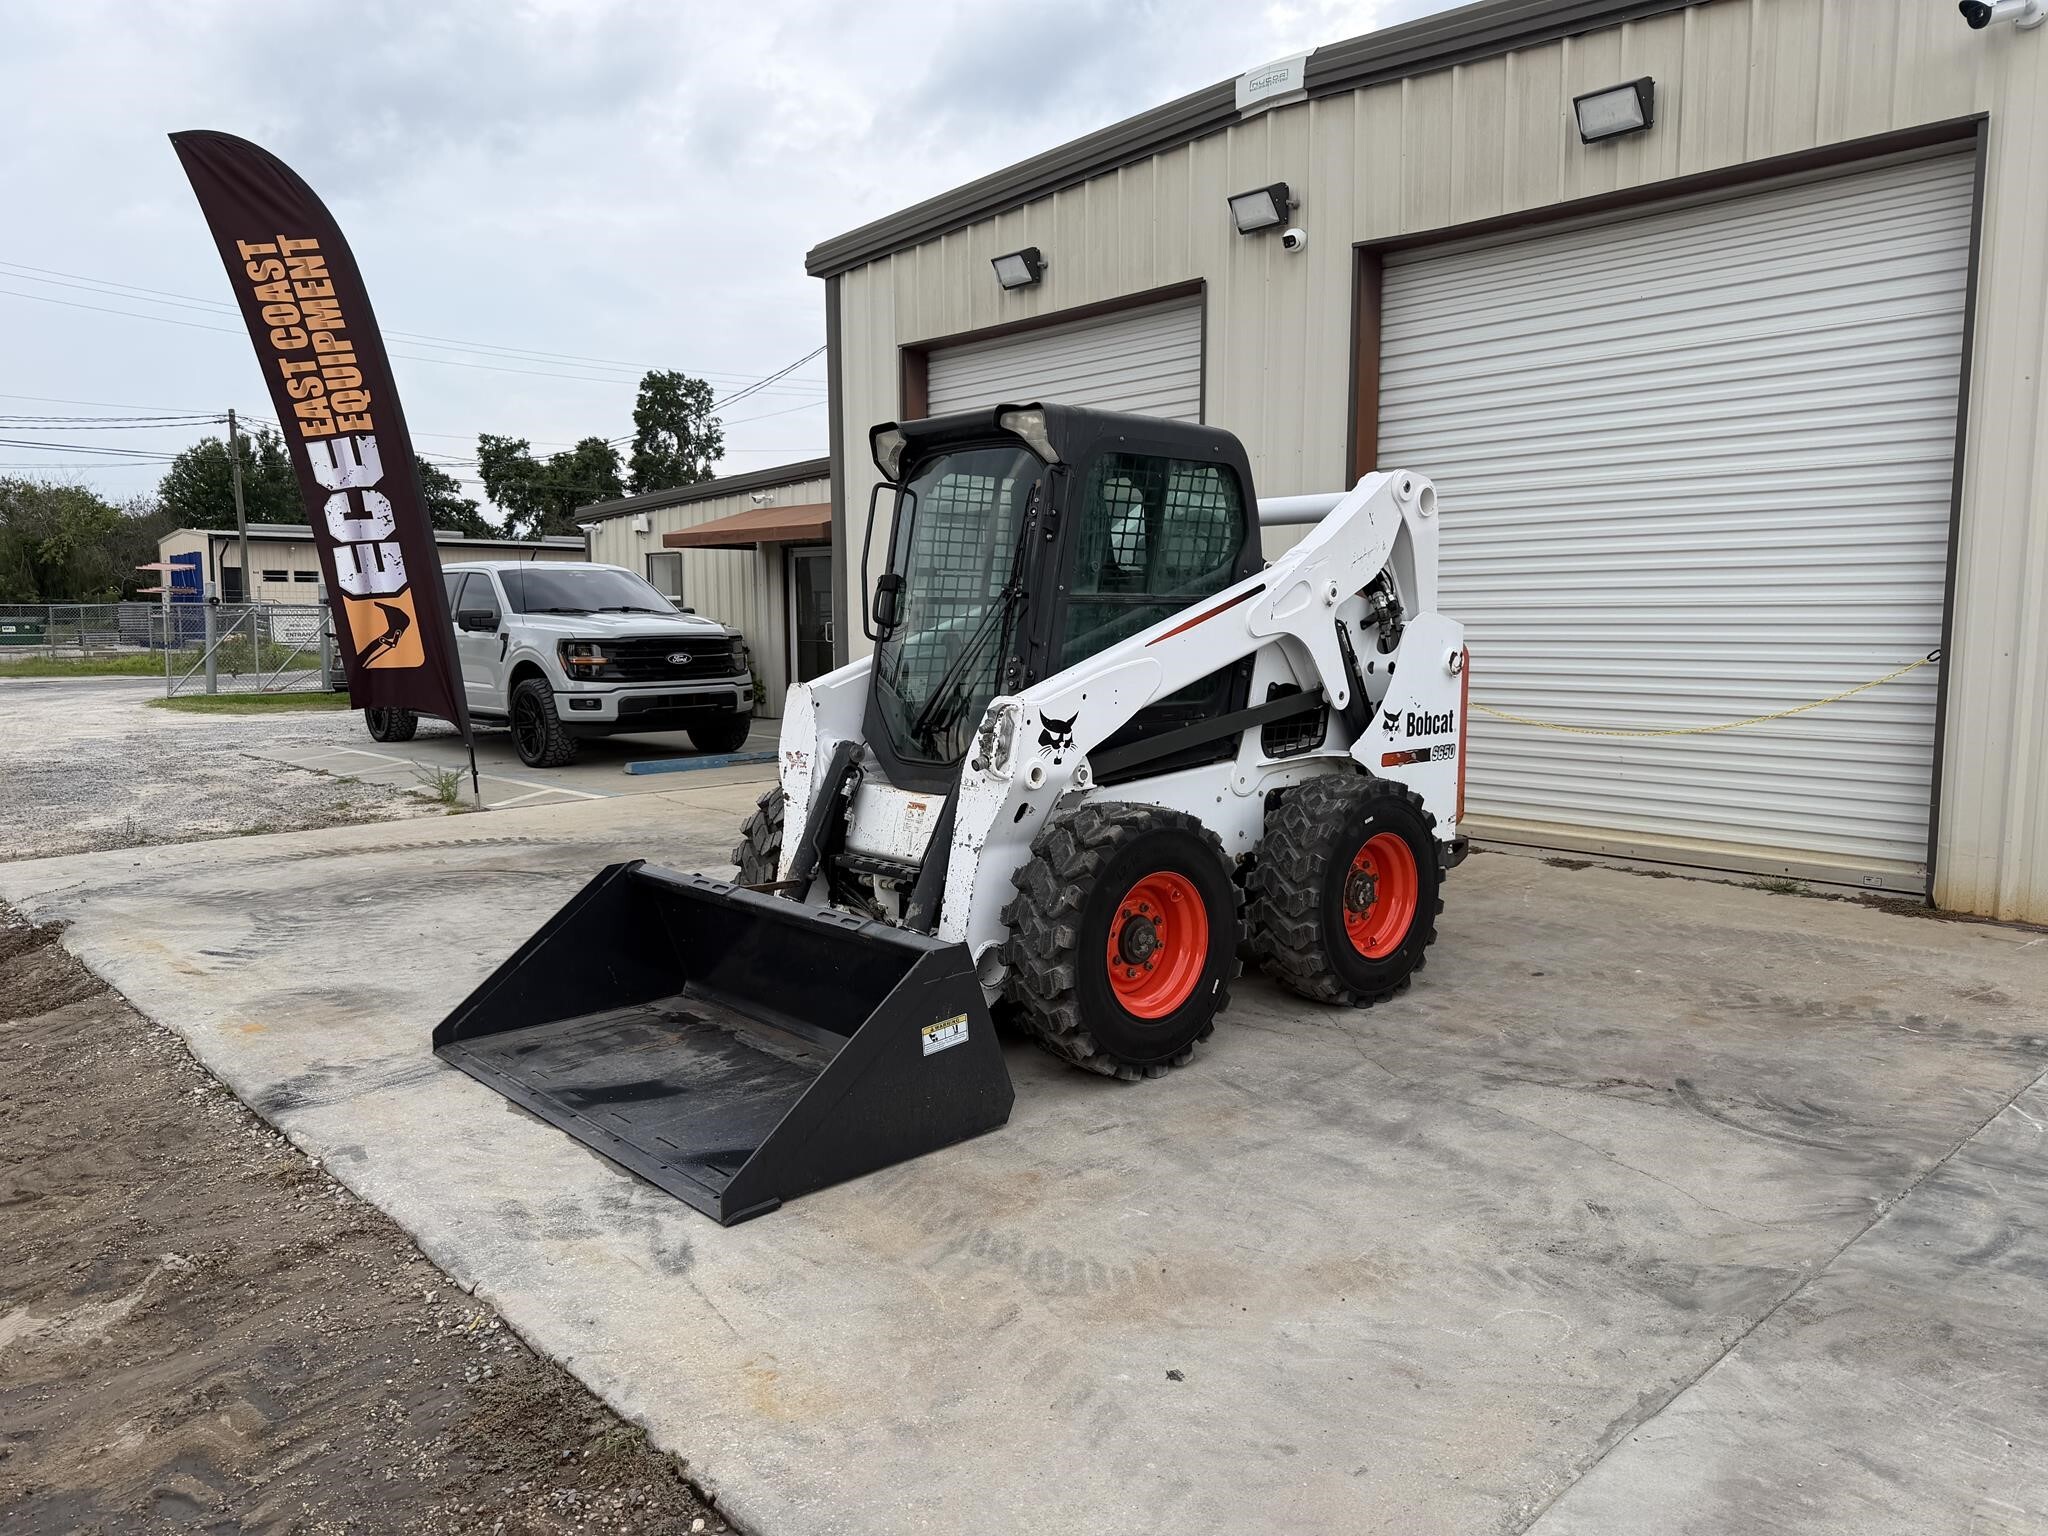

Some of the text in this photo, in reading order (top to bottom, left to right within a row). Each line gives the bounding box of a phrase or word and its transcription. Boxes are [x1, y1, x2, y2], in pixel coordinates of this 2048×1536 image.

[1252, 72, 1286, 87] NUCOR
[237, 239, 336, 437] EAST COAST
[276, 234, 374, 431] EQUIPMENT
[306, 434, 407, 594] ECE
[670, 654, 689, 664] Ford
[1407, 710, 1453, 737] Bobcat
[1432, 744, 1456, 761] S650
[935, 1018, 960, 1030] WARNING
